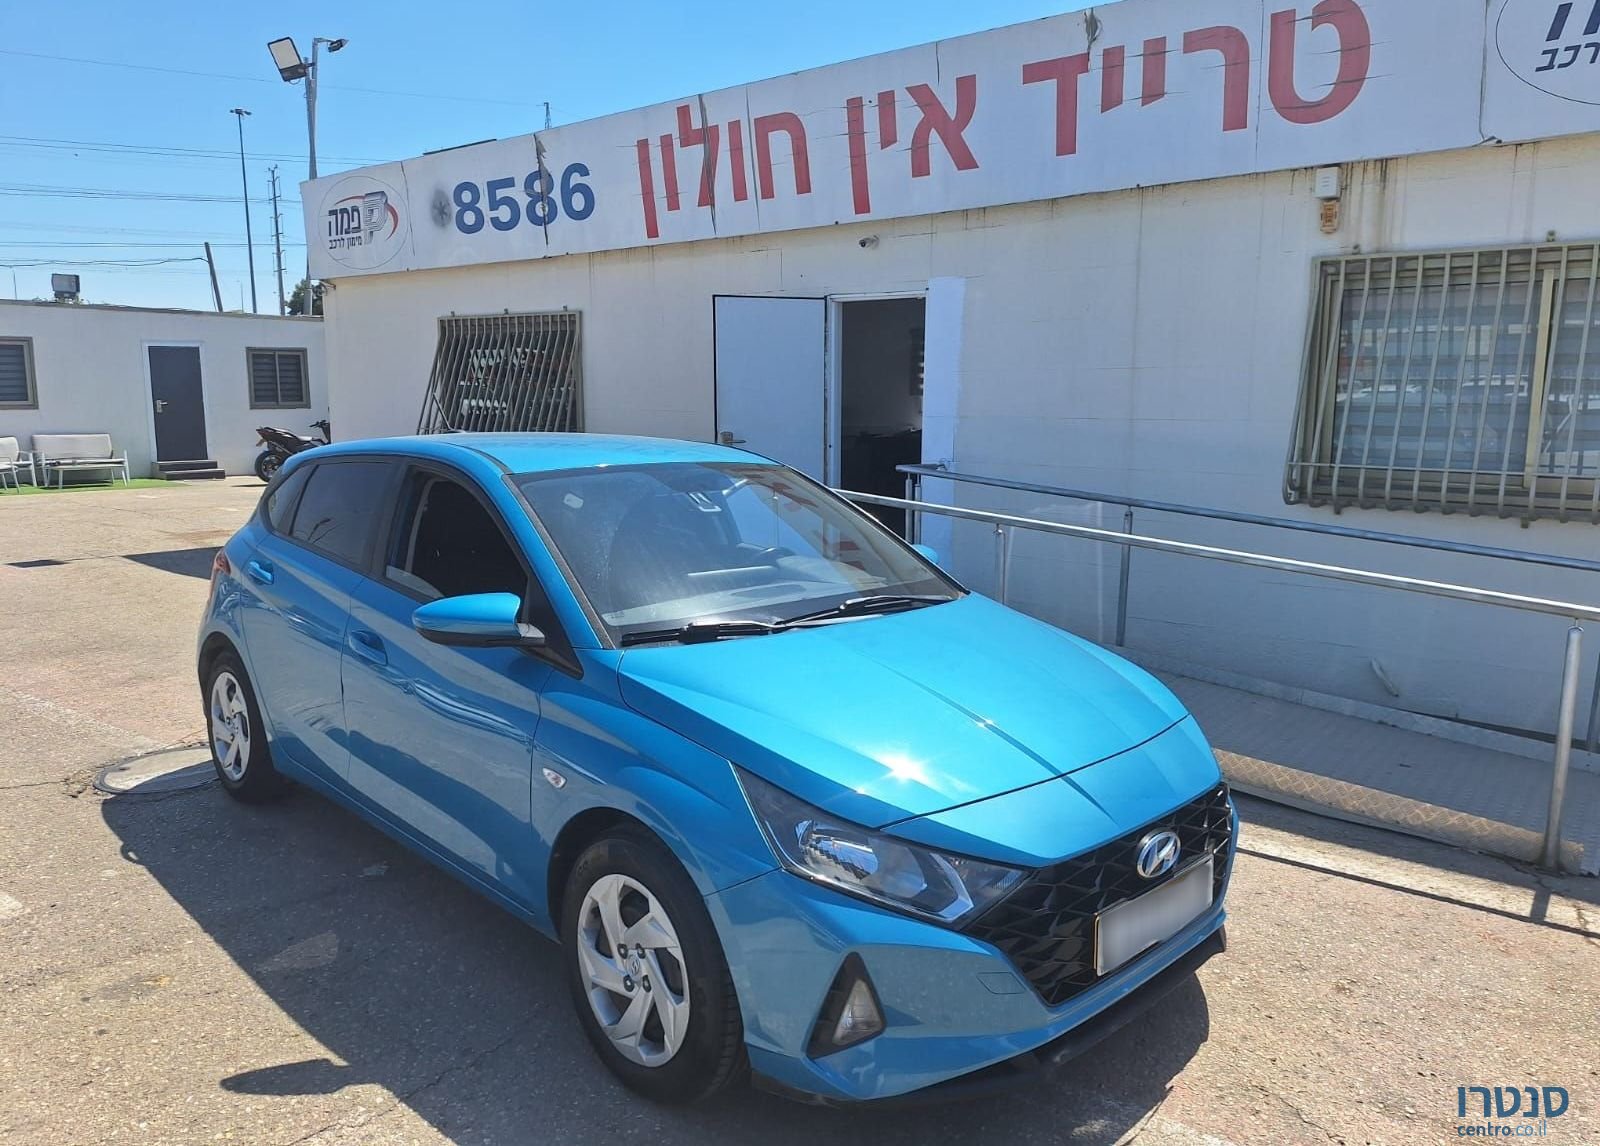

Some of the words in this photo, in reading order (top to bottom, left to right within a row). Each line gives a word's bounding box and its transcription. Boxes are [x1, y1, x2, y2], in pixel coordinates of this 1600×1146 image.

[1022, 0, 1371, 156] טרייד
[636, 104, 812, 239] חולון
[846, 73, 980, 215] אין
[328, 205, 362, 237] פמה
[328, 237, 345, 250] לרכב
[347, 236, 363, 250] מימון
